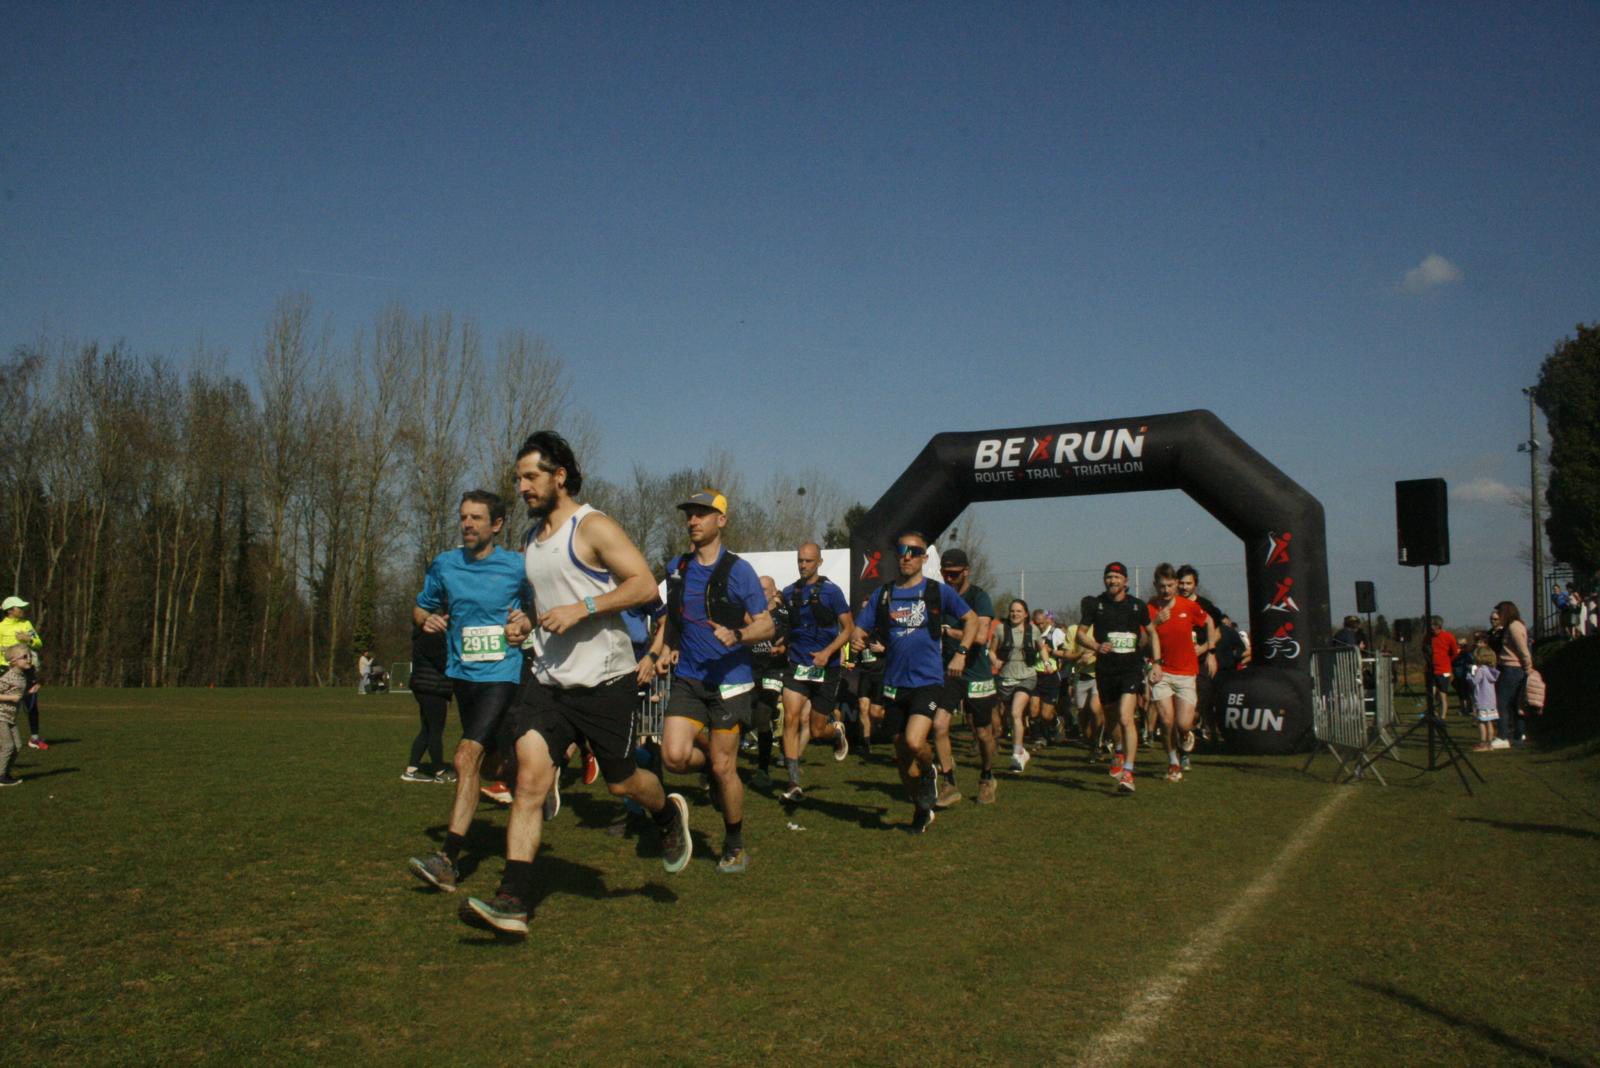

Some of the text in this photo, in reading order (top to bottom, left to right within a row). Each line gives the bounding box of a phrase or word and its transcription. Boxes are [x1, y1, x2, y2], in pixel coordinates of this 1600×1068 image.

[975, 461, 1144, 483] ROUTE TRAIL TRIATHLON
[463, 635, 500, 651] 2915
[1227, 693, 1245, 705] BE
[1225, 707, 1286, 731] RUN
